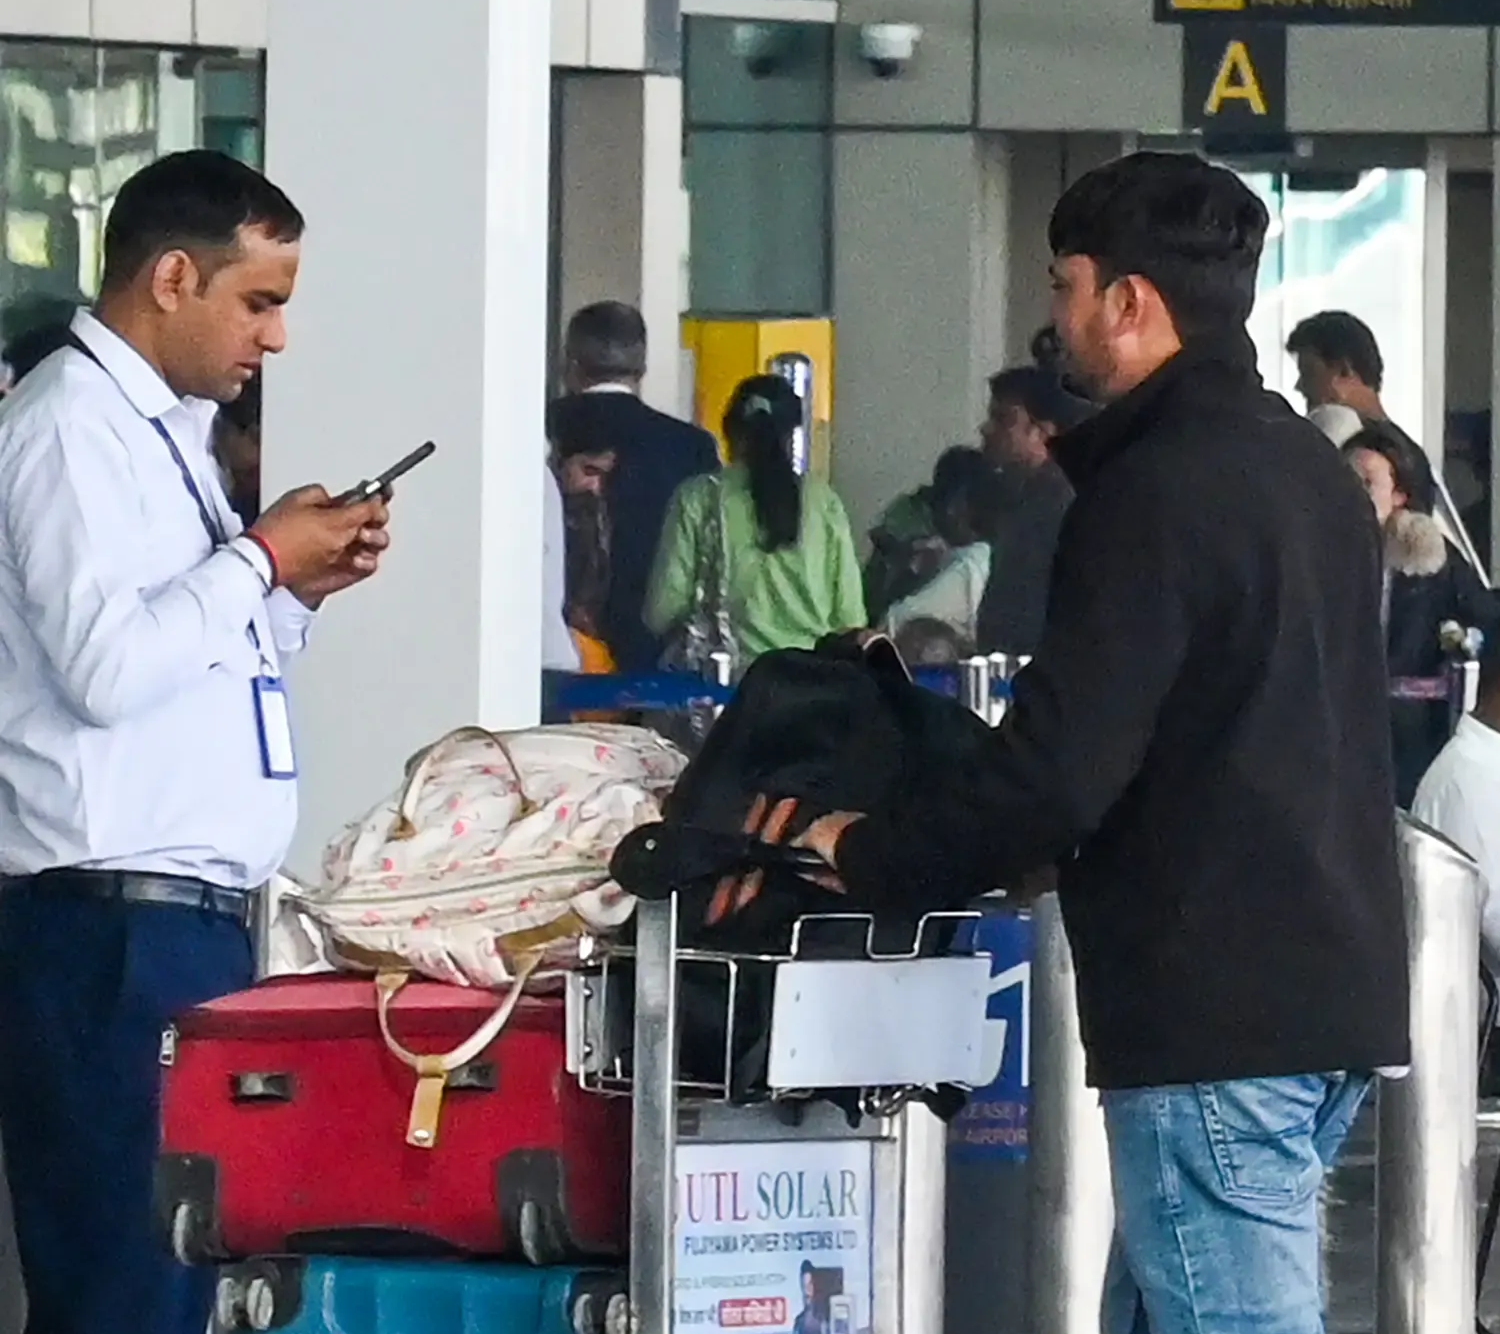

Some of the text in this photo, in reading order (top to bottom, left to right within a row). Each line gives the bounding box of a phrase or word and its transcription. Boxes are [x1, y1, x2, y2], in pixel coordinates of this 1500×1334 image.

[1204, 39, 1268, 116] A
[686, 1169, 859, 1223] UTL SOLAR
